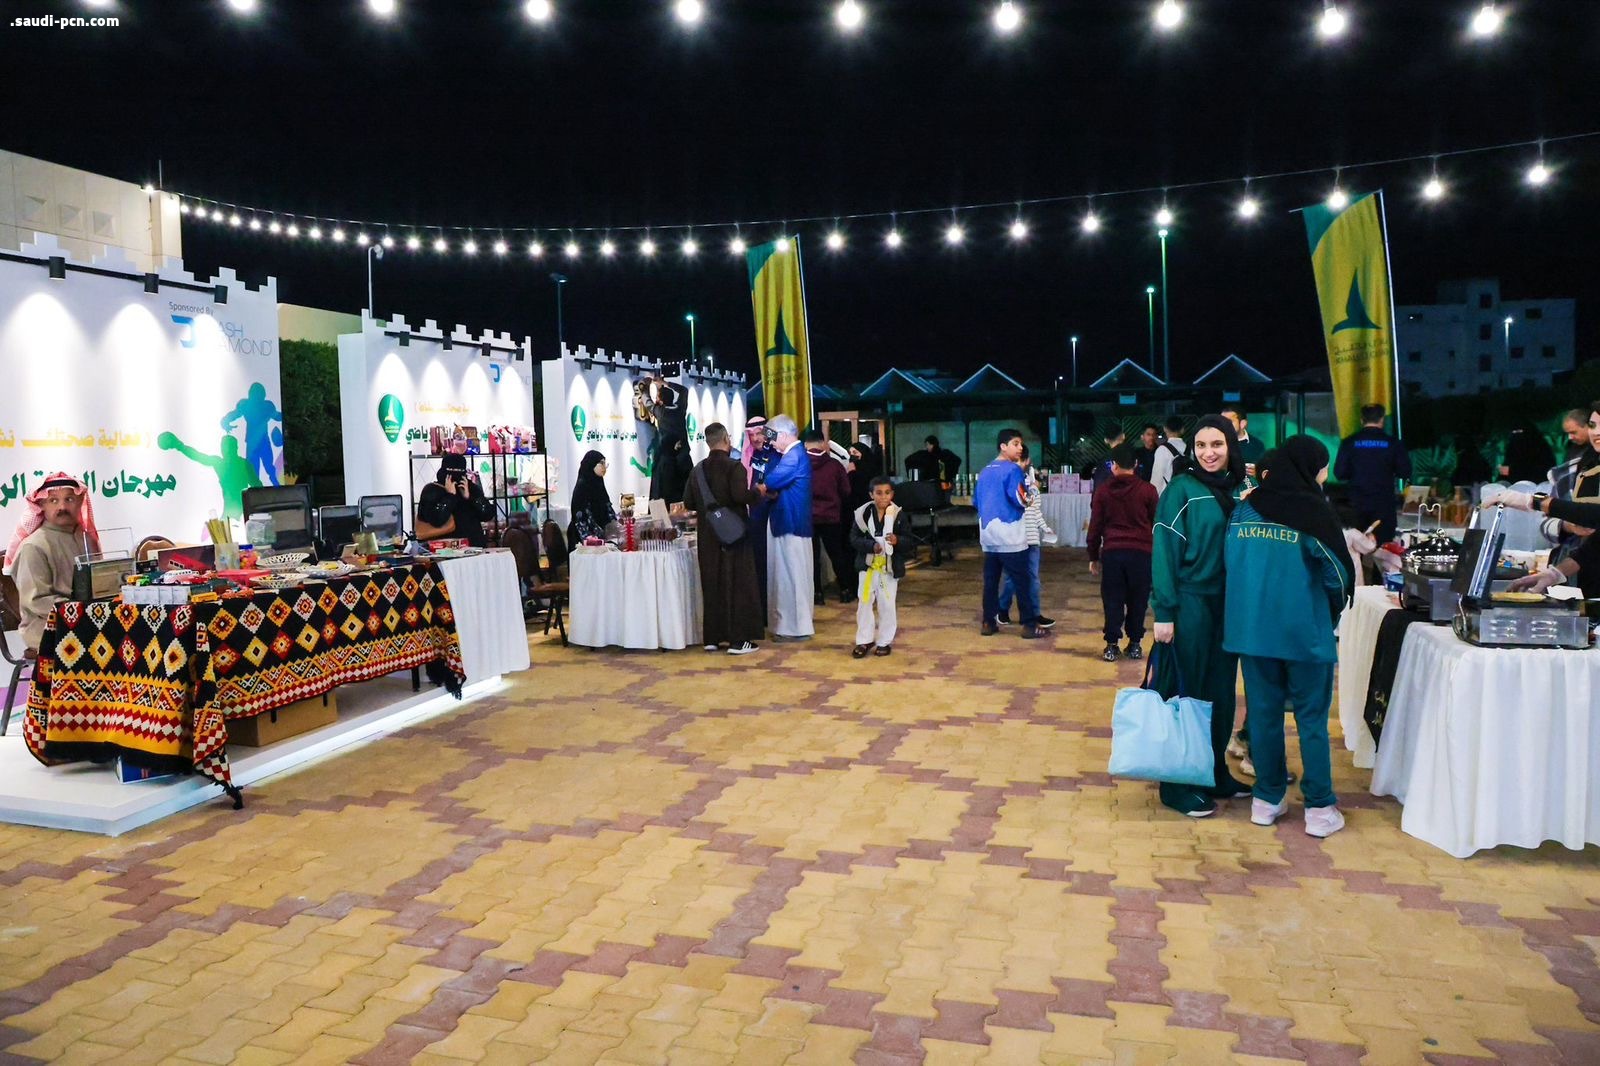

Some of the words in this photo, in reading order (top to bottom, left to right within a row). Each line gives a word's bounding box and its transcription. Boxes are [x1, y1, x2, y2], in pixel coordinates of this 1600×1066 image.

[168, 301, 205, 314] Sponsored
[101, 469, 177, 499] مهرجان
[1237, 526, 1299, 543] ALKHALEEJ
